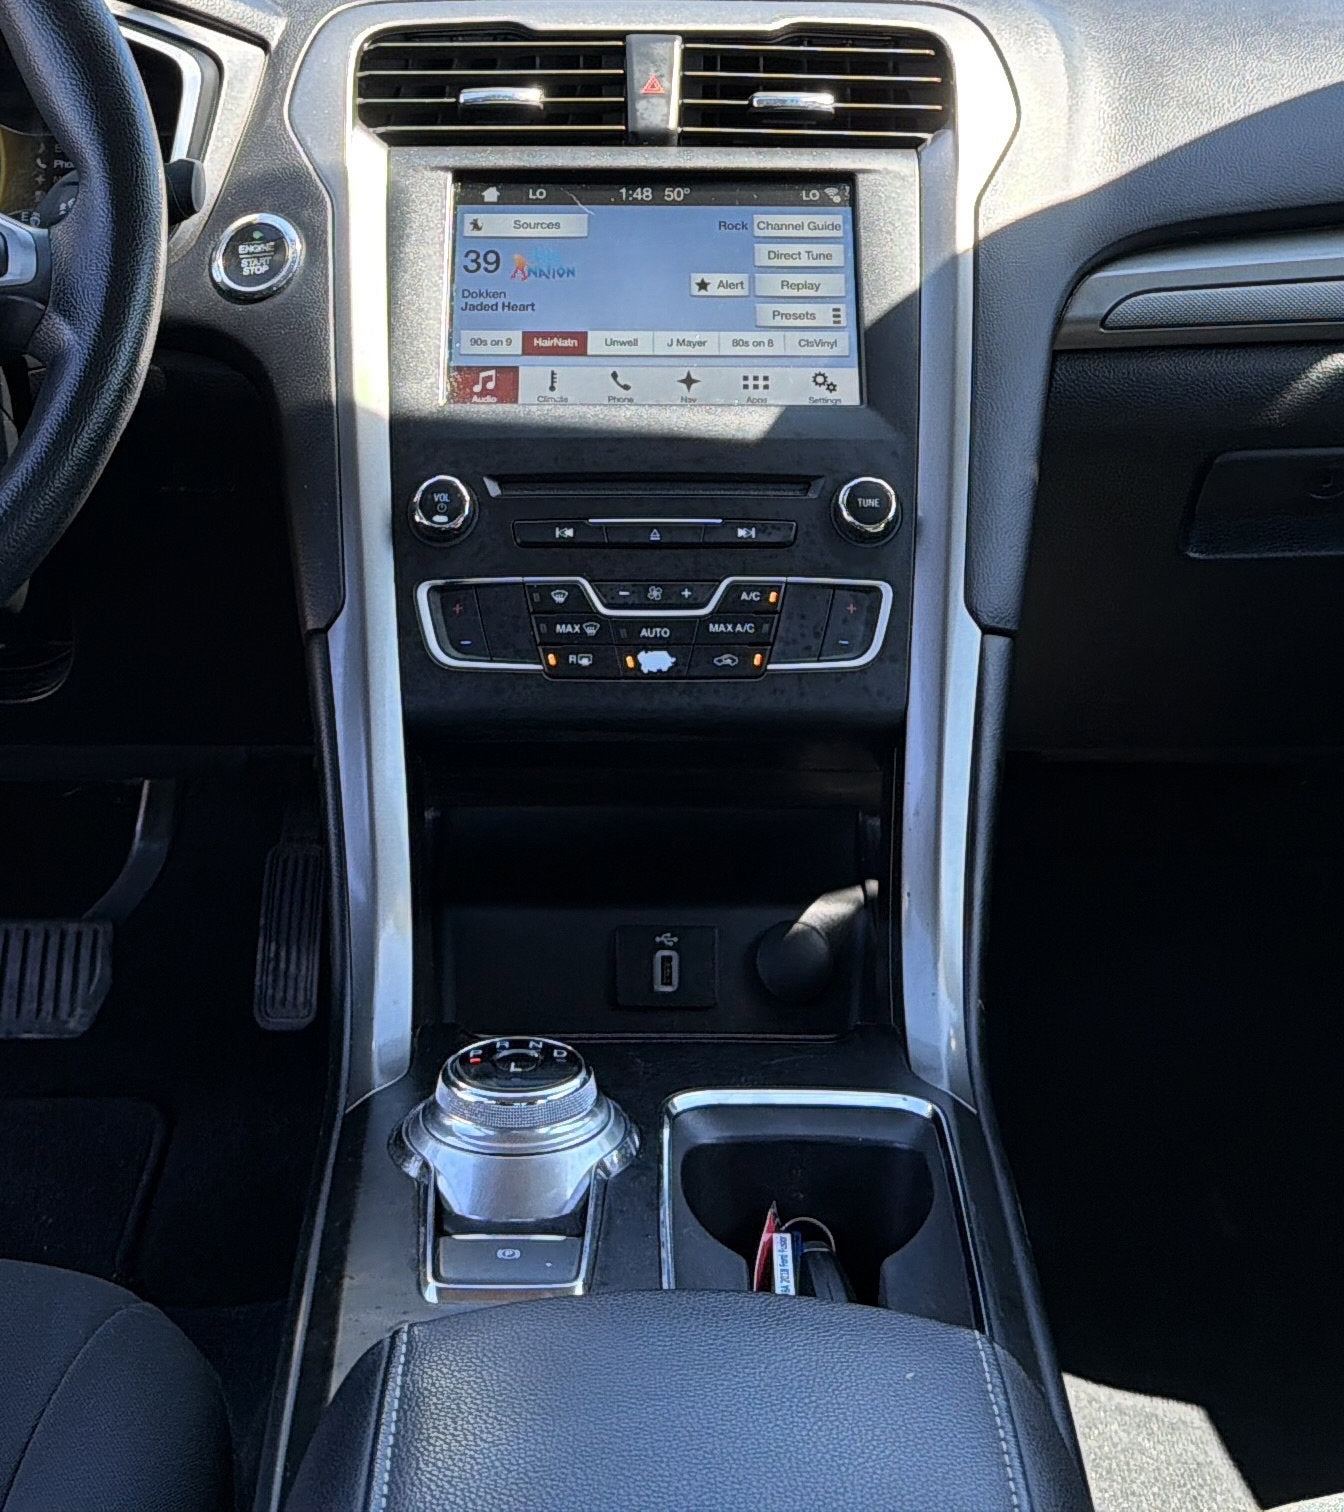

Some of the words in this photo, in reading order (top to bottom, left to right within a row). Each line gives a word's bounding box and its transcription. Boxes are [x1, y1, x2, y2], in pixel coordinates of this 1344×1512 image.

[53, 159, 74, 168] Pho
[529, 188, 547, 199] LO
[619, 187, 653, 201] 1:48
[802, 190, 820, 201] LO
[513, 219, 561, 230] Sources
[718, 220, 749, 231] Rock
[756, 220, 805, 232] Channel
[807, 220, 842, 232] Guide
[238, 241, 275, 254] ENGINE
[767, 250, 802, 261] Direct
[805, 251, 833, 261] Tune
[241, 257, 272, 267] START
[462, 249, 501, 274] 39
[242, 265, 270, 276] STOP
[716, 279, 745, 290] Alert
[780, 279, 821, 292] Replay
[461, 289, 507, 299] Dokken
[461, 301, 499, 312] Jaded
[501, 301, 536, 312] Heart
[772, 310, 817, 321] Presets
[470, 337, 488, 347] 90s
[490, 339, 503, 347] on
[505, 337, 513, 347] 9
[533, 337, 578, 347] HairNatn
[605, 337, 639, 347] Unwell
[666, 338, 674, 348] J
[676, 338, 707, 349] Mayer
[732, 338, 750, 348] 80s
[752, 340, 765, 348] on
[767, 338, 775, 348] 8
[471, 395, 497, 404] Audio
[608, 395, 634, 404] Phone
[808, 396, 842, 405] Settings
[433, 492, 451, 503] VOL
[856, 497, 881, 509] TUNE
[740, 590, 761, 602] A/C
[556, 623, 581, 635] MAX
[639, 627, 670, 639] AUTO
[708, 622, 734, 634] MAX
[735, 622, 755, 634] A/C
[469, 1049, 483, 1058] P
[528, 1041, 543, 1049] N
[553, 1049, 568, 1058] D
[509, 1061, 523, 1073] L
